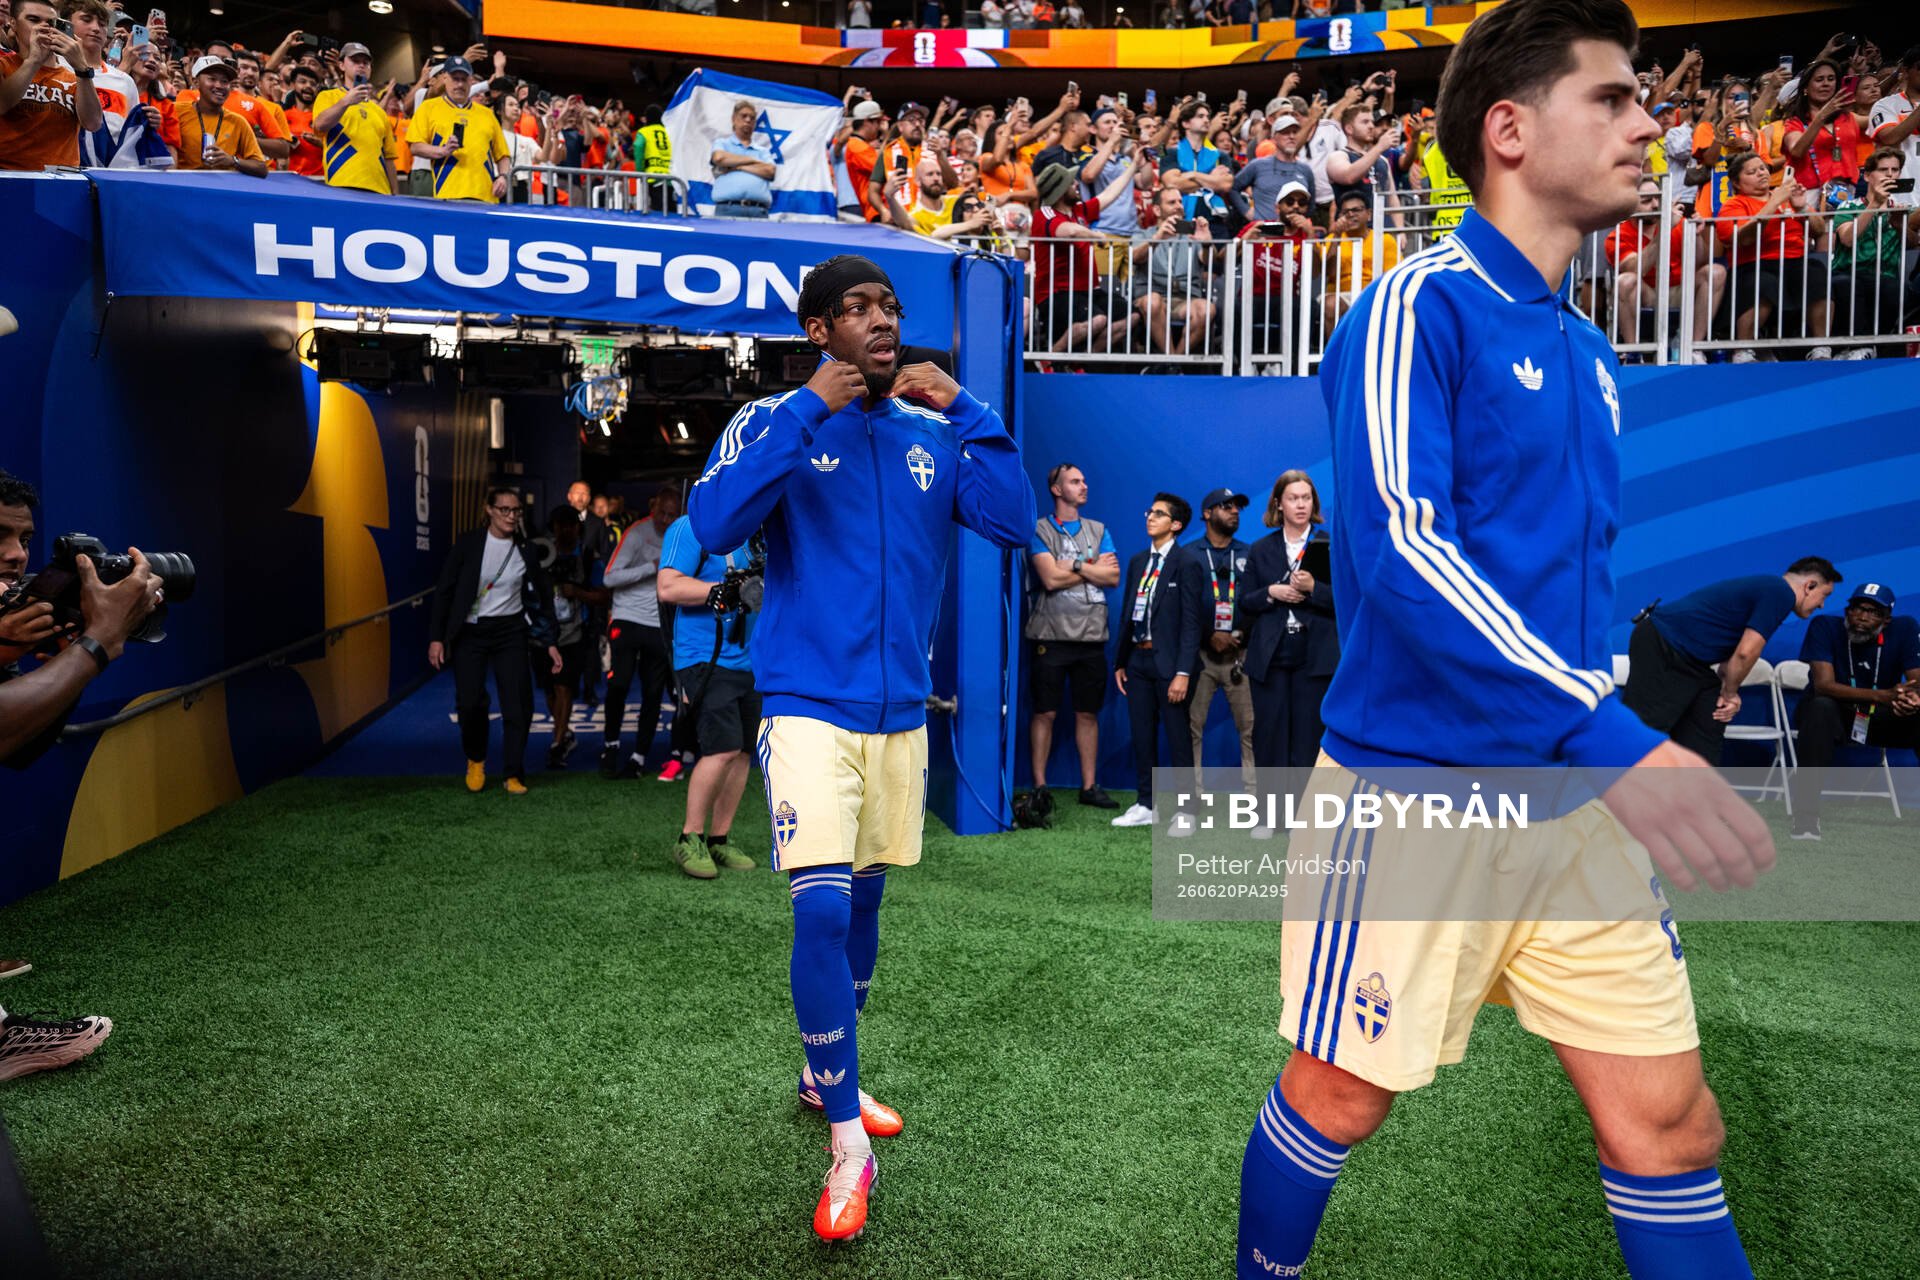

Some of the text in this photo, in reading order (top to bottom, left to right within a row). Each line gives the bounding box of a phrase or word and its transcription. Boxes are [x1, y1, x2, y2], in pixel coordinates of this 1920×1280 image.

[22, 83, 76, 113] EXAS
[253, 222, 813, 313] HOUSTON
[801, 1026, 846, 1046] SVERIGE
